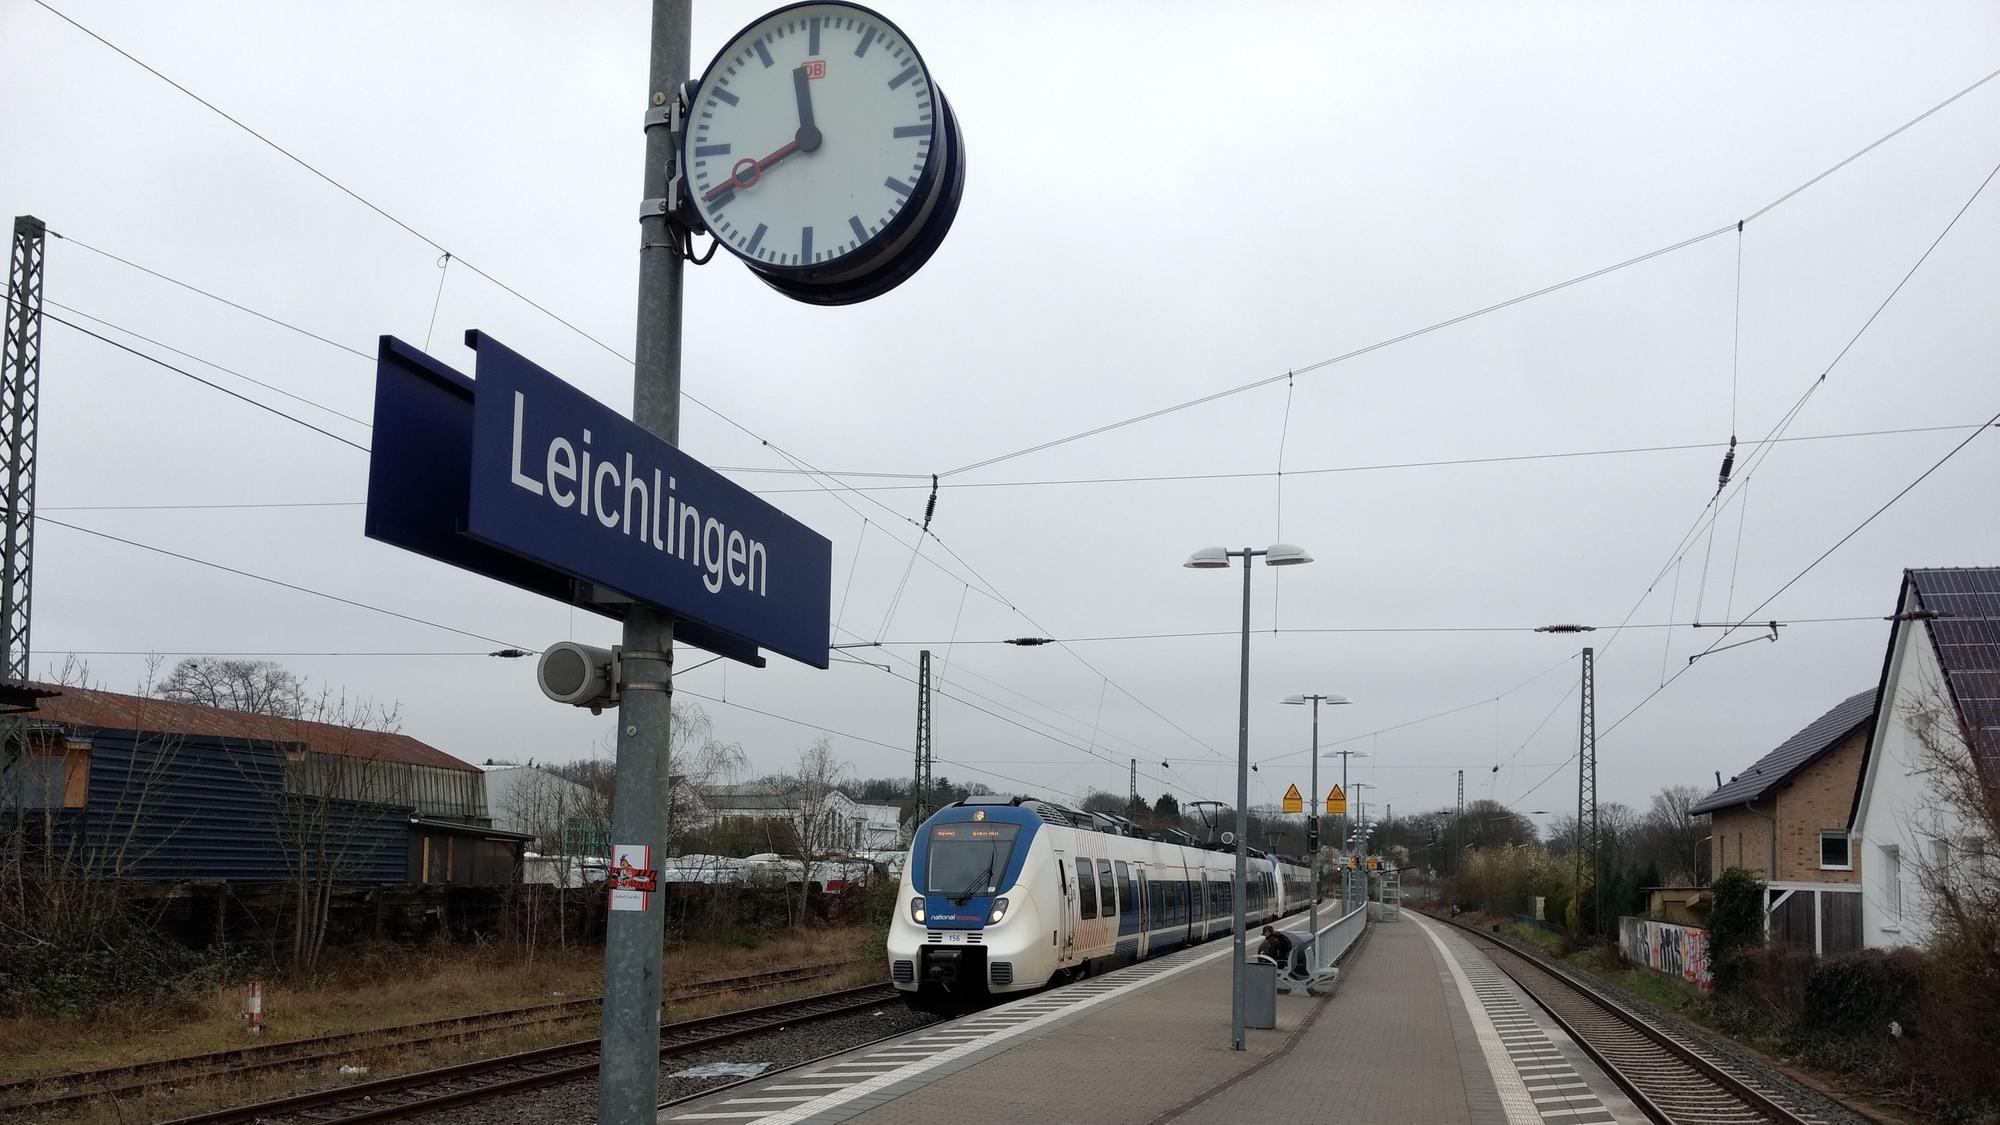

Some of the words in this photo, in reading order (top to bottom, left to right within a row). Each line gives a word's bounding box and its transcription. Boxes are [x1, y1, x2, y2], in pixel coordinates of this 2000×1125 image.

[803, 62, 824, 78] DB
[511, 390, 767, 598] Leichlingen
[930, 913, 956, 921] national
[949, 934, 961, 942] 156
